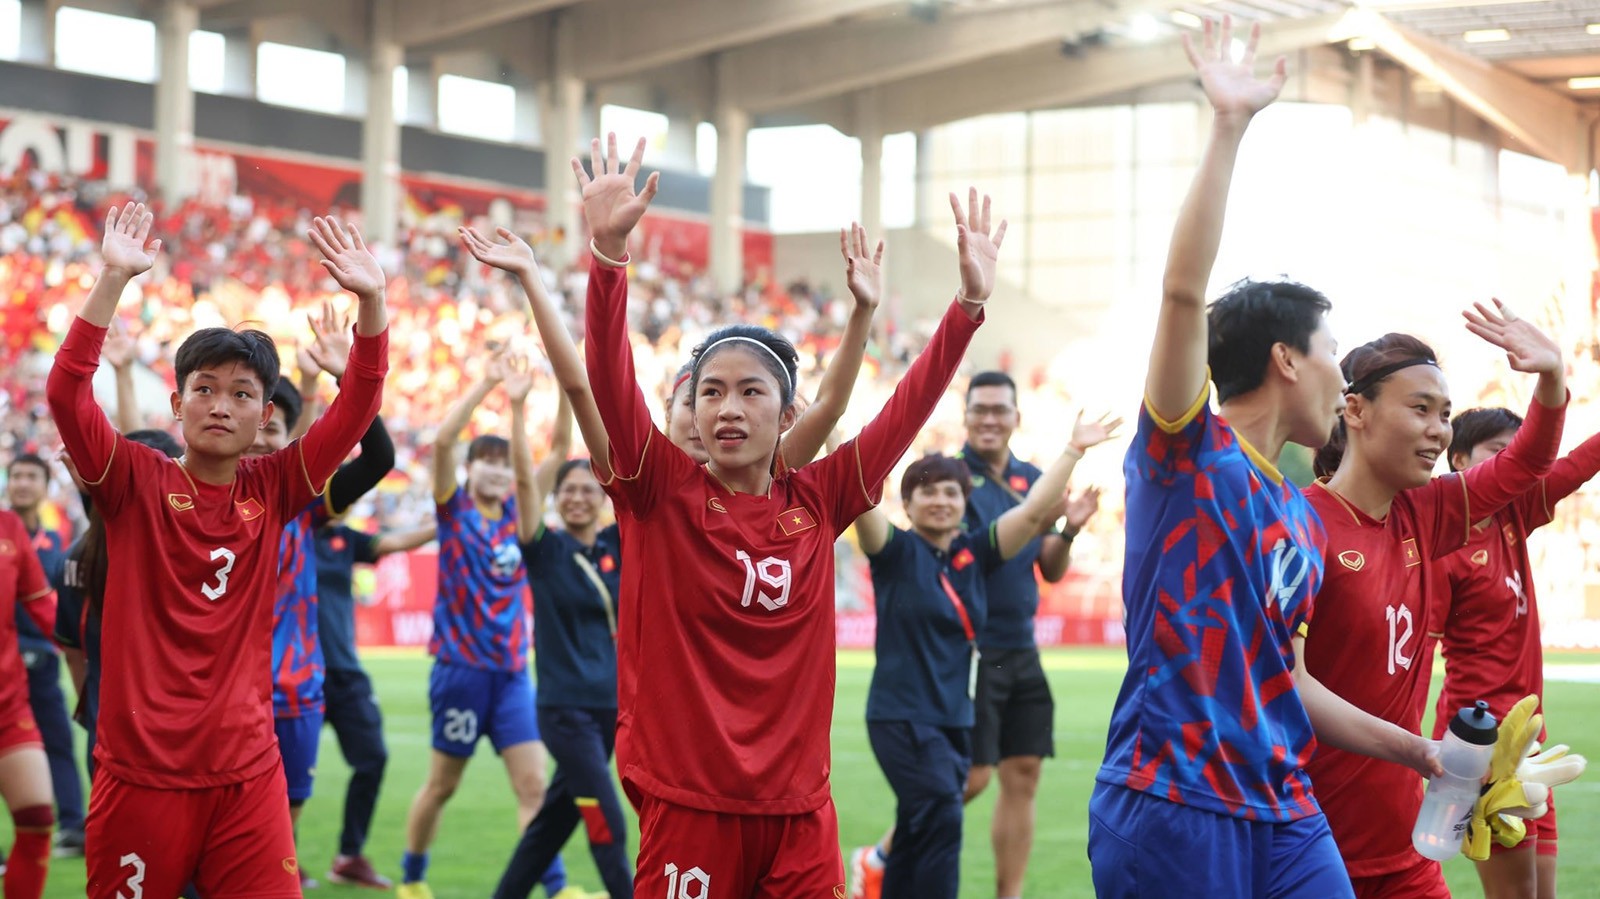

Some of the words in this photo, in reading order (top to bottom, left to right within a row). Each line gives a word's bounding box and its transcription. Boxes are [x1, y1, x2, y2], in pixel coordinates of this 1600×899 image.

[200, 546, 237, 601] 3
[735, 549, 792, 612] 19
[1385, 603, 1416, 676] 12
[443, 708, 478, 744] 20
[116, 852, 146, 899] 3
